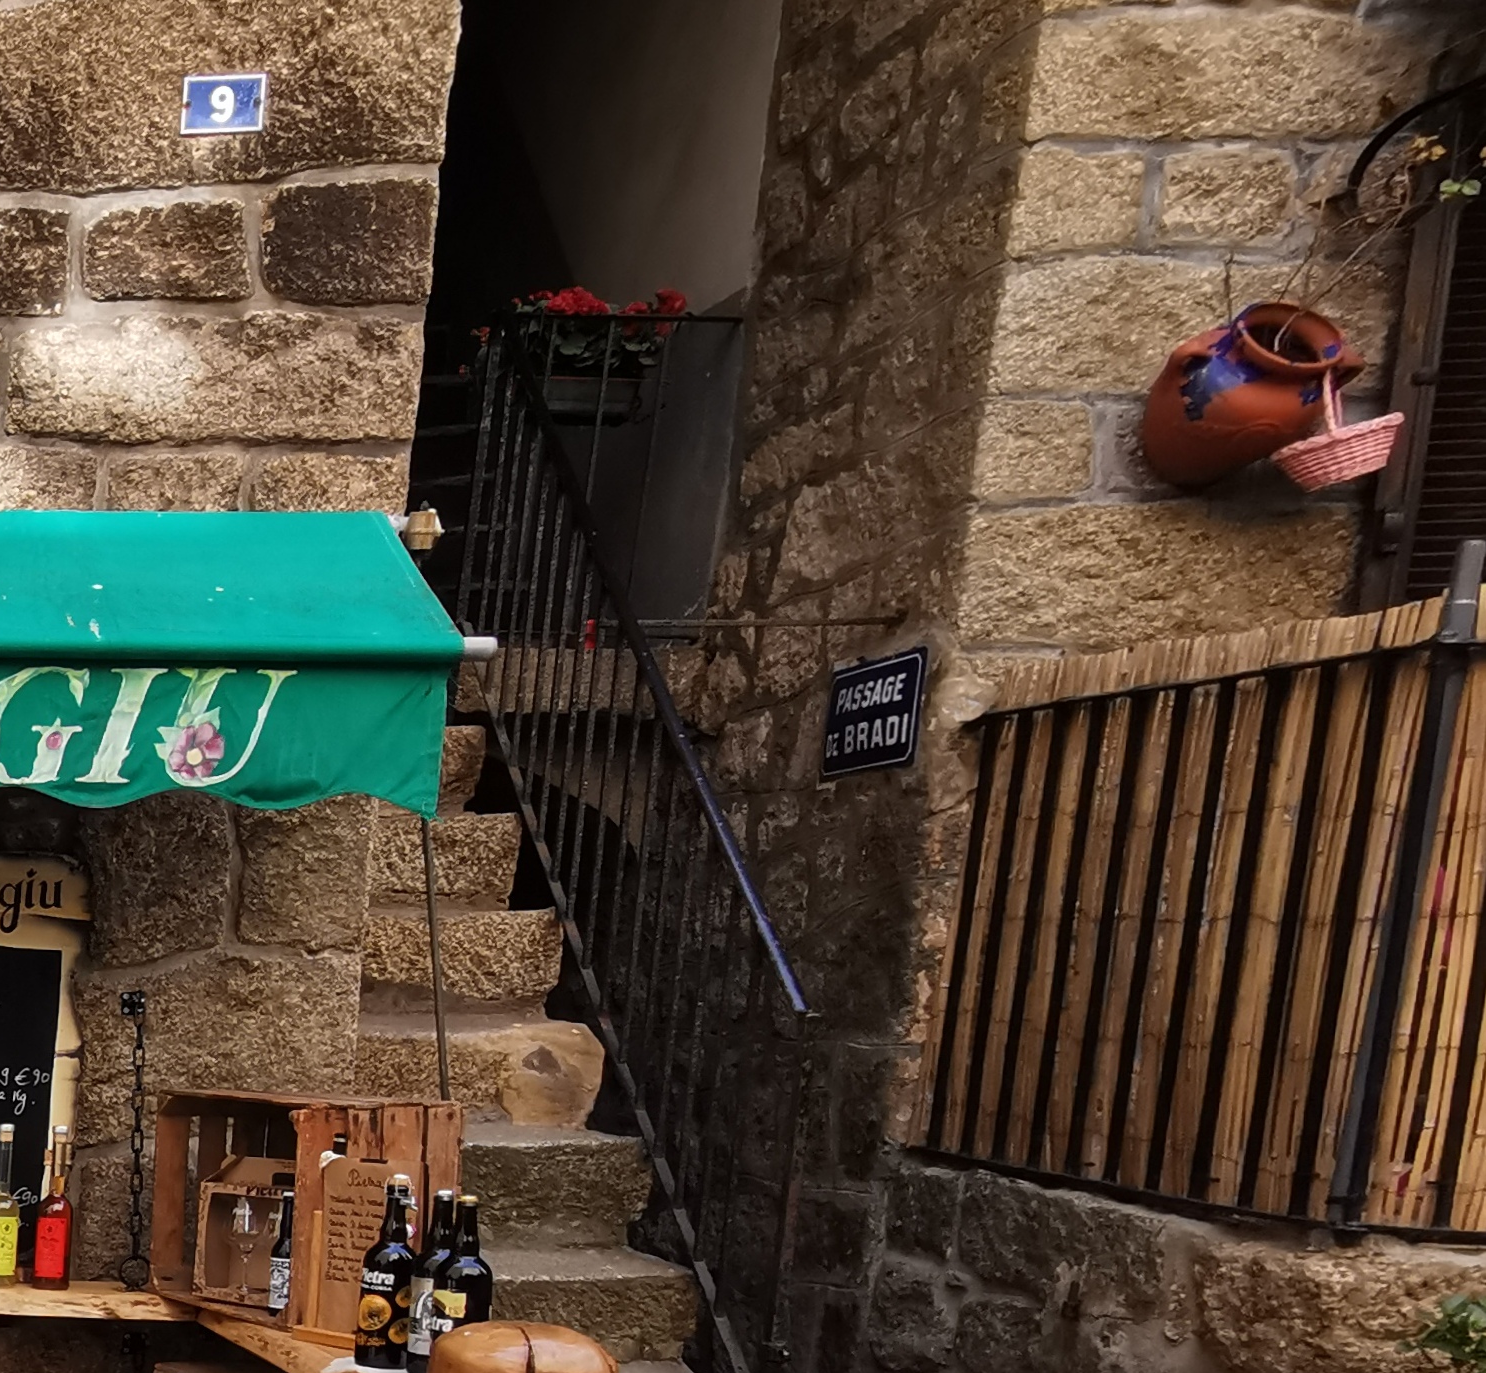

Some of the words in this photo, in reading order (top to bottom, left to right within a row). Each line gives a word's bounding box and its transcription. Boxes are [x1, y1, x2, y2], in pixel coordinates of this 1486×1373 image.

[210, 86, 234, 122] 9
[835, 673, 907, 715] PASSAGE
[844, 713, 909, 754] BRADI
